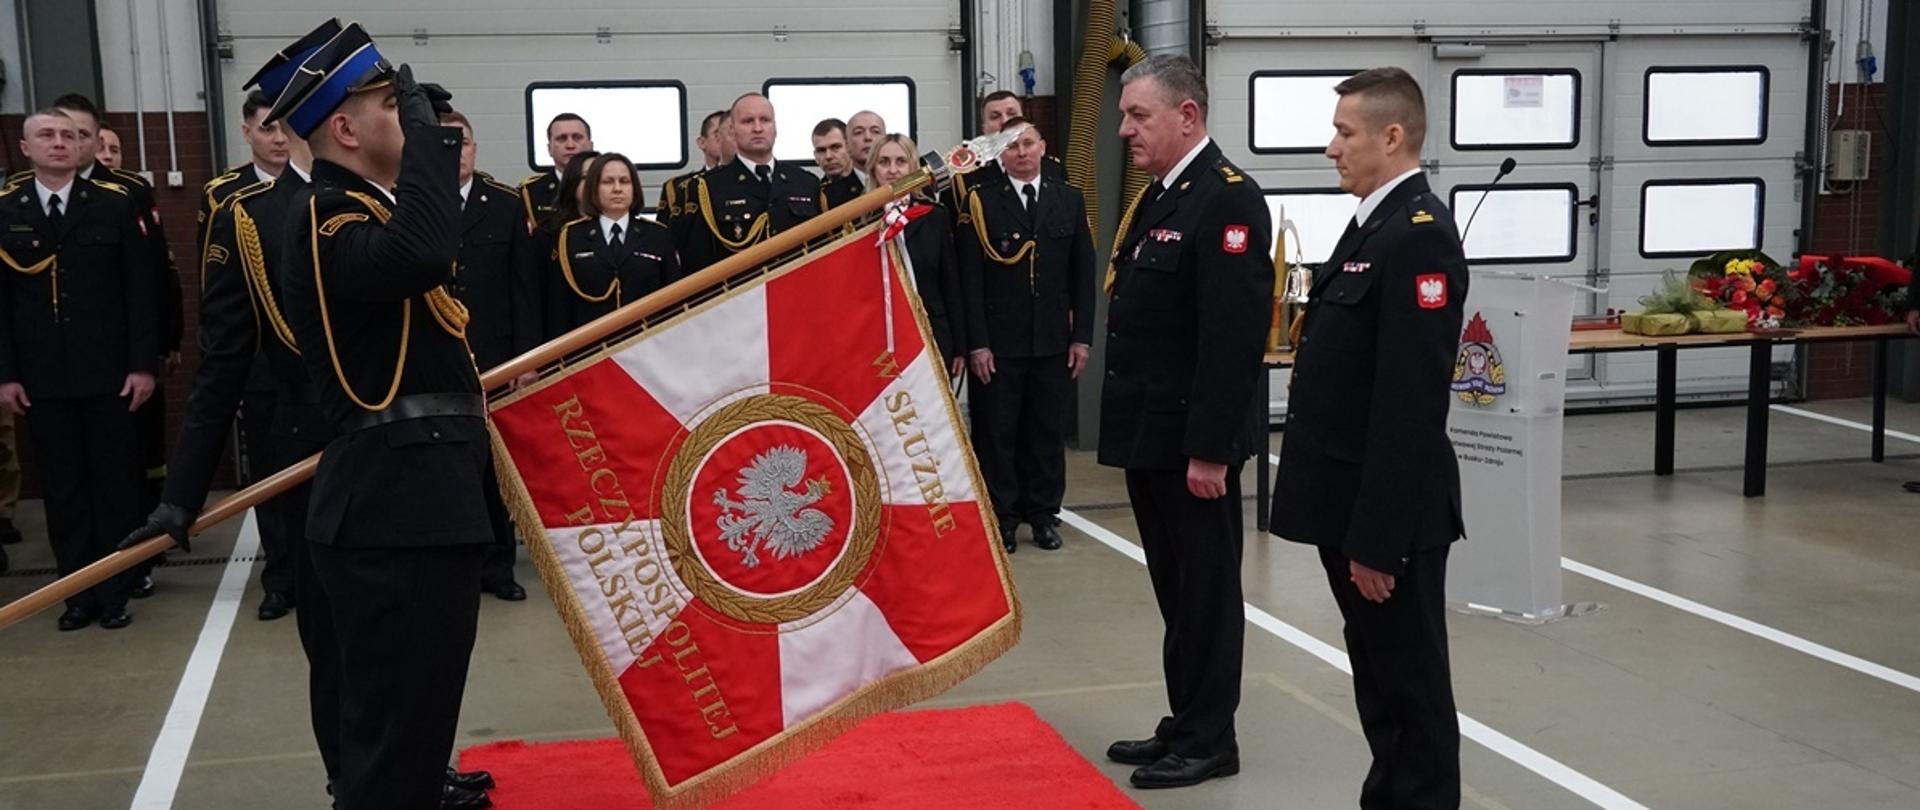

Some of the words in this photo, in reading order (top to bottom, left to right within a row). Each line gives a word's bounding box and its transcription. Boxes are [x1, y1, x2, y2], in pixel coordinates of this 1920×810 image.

[872, 350, 903, 380] W
[884, 389, 956, 539] SŁUŻBIE
[552, 393, 739, 740] RZECZYPOSPOLITEJ
[565, 502, 665, 669] POLSKIEJ
